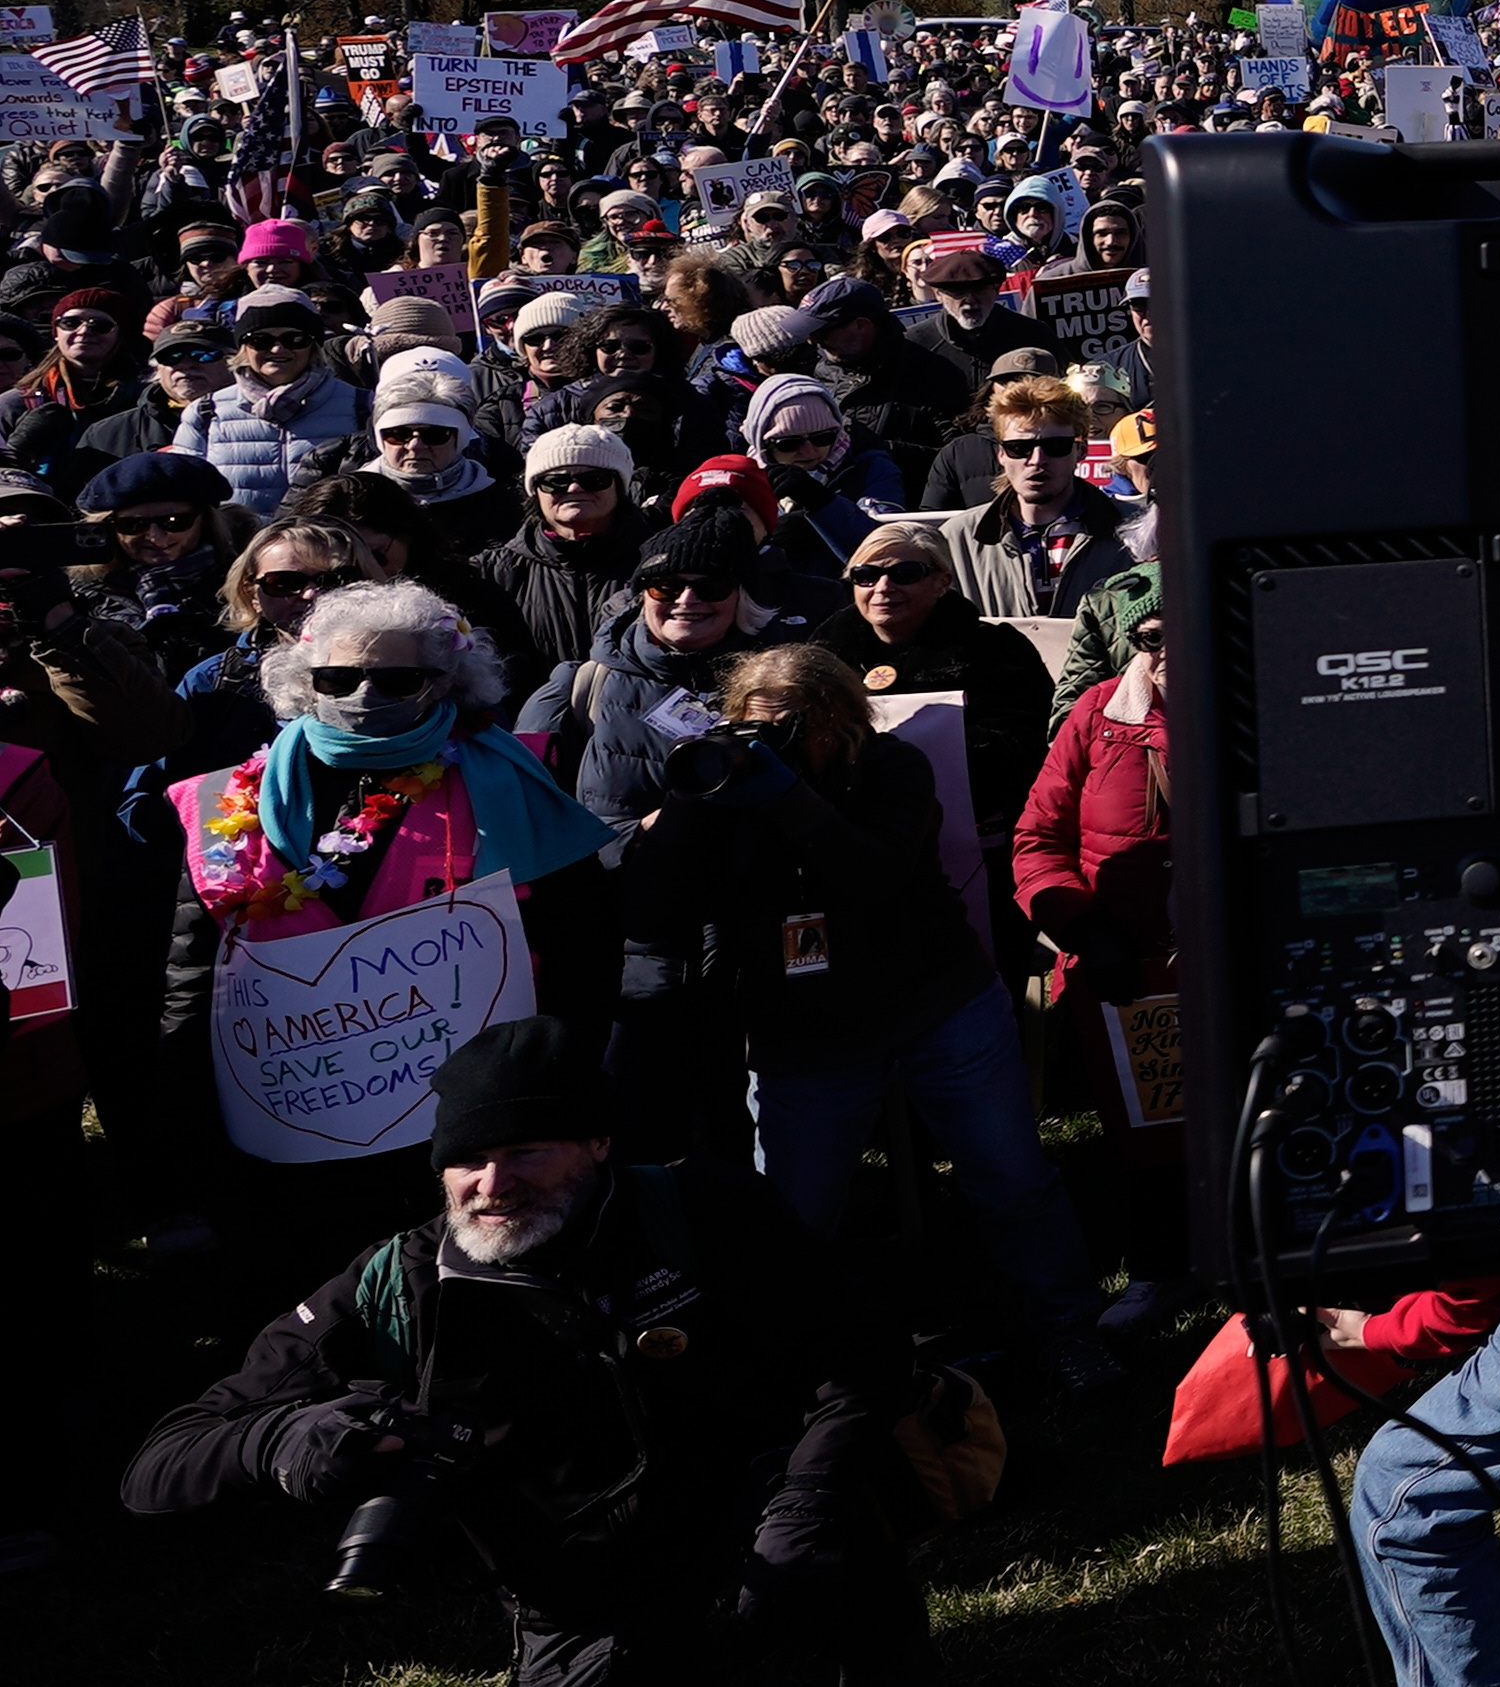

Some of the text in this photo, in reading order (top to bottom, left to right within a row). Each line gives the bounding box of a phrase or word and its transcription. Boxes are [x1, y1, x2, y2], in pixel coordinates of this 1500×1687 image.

[341, 43, 389, 57] TRUMP
[347, 55, 388, 70] MUST
[427, 57, 537, 78] TURN THE
[1247, 58, 1300, 74] HANDS
[360, 68, 380, 81] GO
[1259, 72, 1291, 85] OFF
[445, 78, 524, 97] EPSTEIN
[462, 98, 512, 114] FILES
[416, 116, 458, 133] INTO
[745, 162, 783, 177] CAN
[740, 173, 791, 188] PREVENT
[398, 273, 444, 286] STOP
[1041, 290, 1125, 316] TRUM
[1057, 312, 1133, 340] MUS
[1316, 646, 1430, 678] QSC
[1340, 673, 1406, 692] K12.2
[1343, 686, 1446, 702] ACTIVE LOUDSPEAKER
[350, 921, 484, 992] MOM
[786, 953, 828, 968] ZUMA
[227, 972, 269, 1008] THIS
[1130, 1029, 1183, 1059] Kin
[260, 1018, 457, 1088] SAVE OUR
[1148, 1080, 1183, 1112] 17
